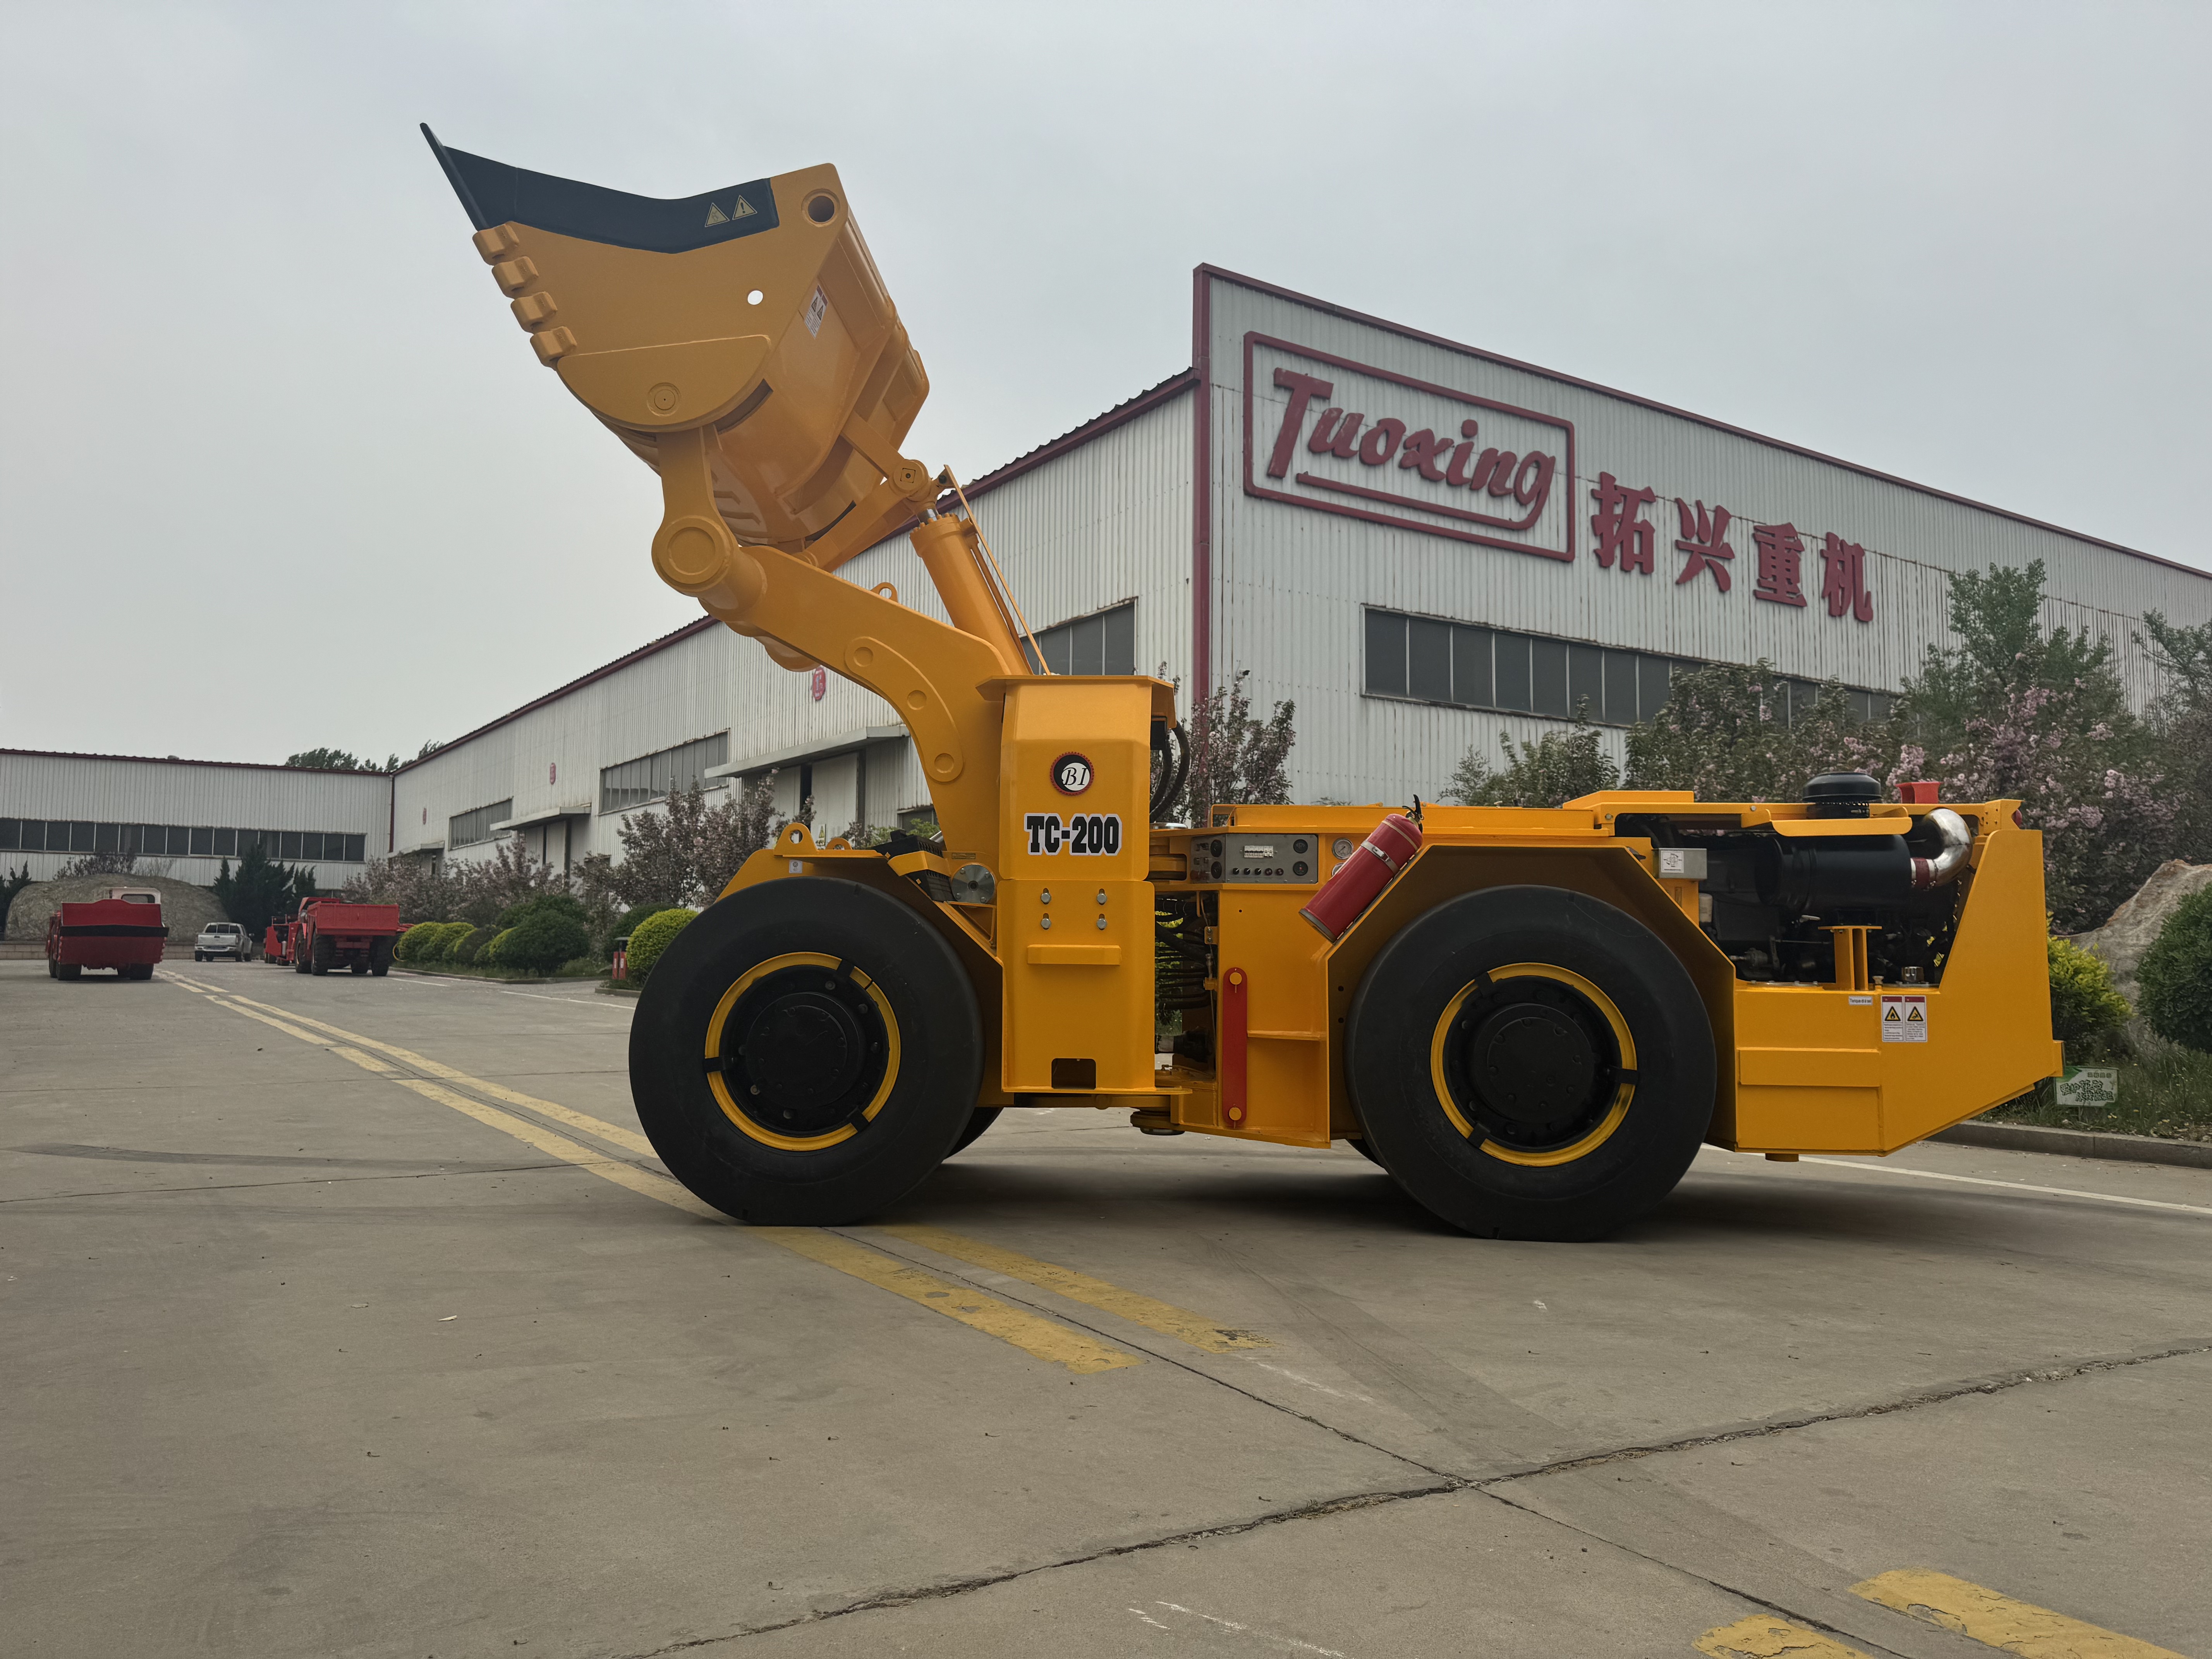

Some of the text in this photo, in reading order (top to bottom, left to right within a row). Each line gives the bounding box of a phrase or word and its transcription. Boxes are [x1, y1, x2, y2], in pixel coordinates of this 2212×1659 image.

[1267, 367, 1556, 530] Tuoxing
[1591, 471, 1874, 622] 拓兴重机
[1027, 816, 1119, 854] TC-200
